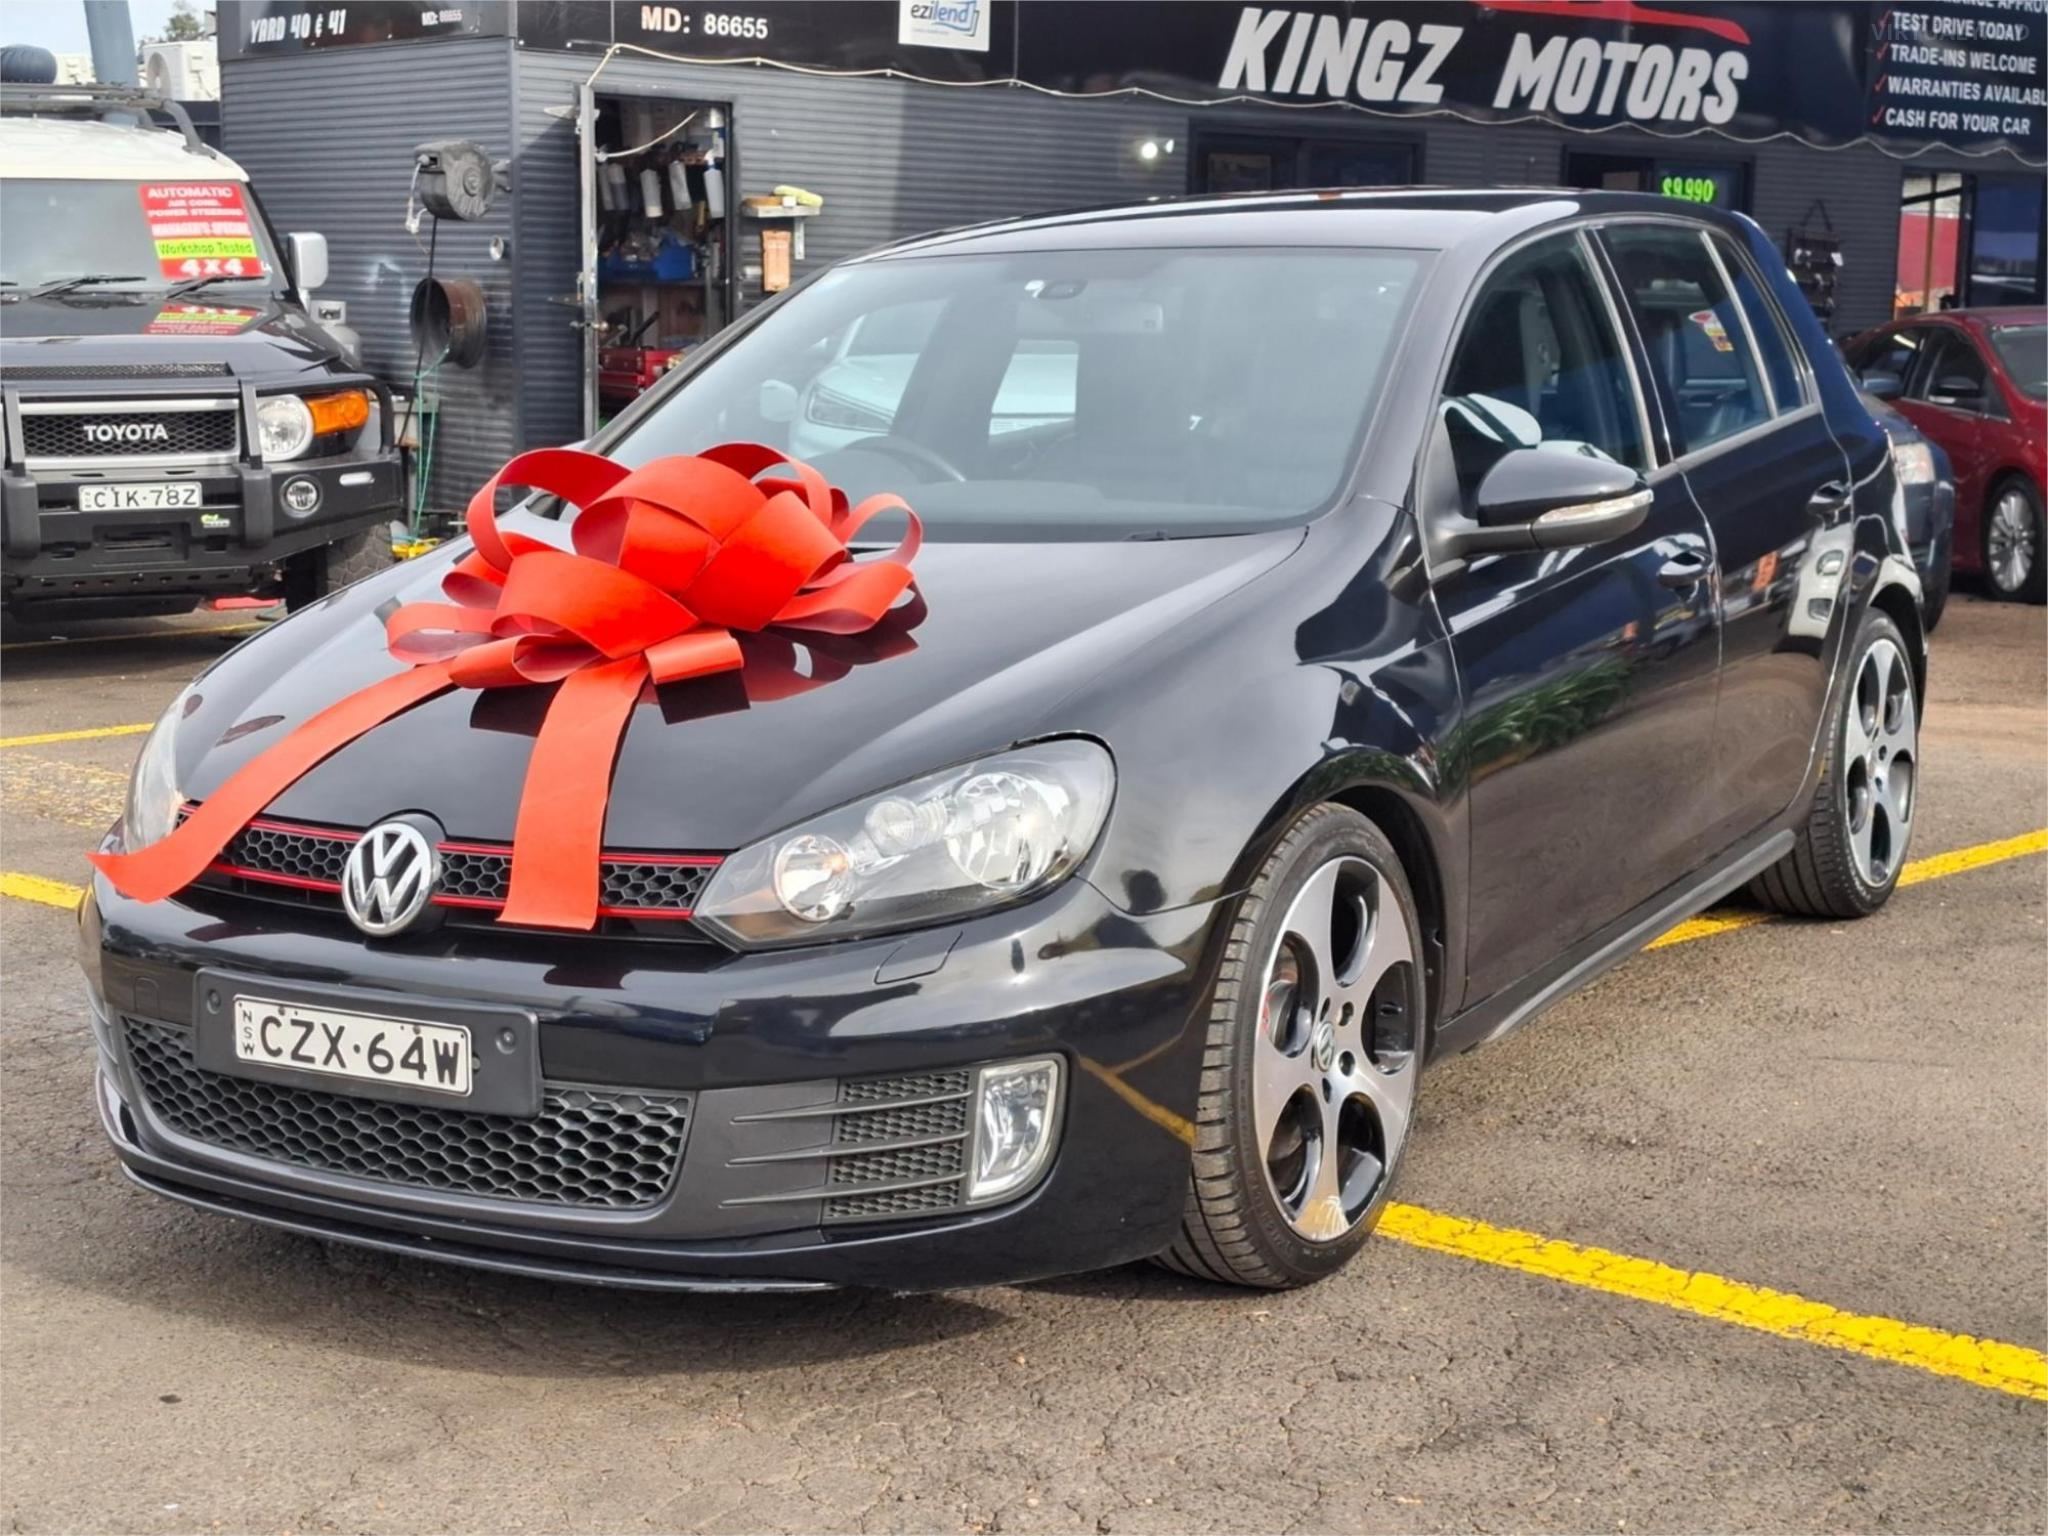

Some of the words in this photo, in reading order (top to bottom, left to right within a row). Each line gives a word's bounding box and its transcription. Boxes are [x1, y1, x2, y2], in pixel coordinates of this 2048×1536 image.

[250, 16, 285, 43] YARD
[289, 13, 311, 39] 40
[328, 9, 347, 35] 41
[641, 6, 690, 33] MD:
[703, 13, 768, 39] 86655
[1893, 11, 1929, 32] TEST
[1932, 16, 1974, 37] DRIVE
[1978, 20, 2024, 41] TODAY
[1218, 7, 1463, 104] KINGZ
[1493, 32, 1750, 125] MOTORS
[1891, 44, 1966, 68] TRADE-INS
[1970, 51, 2037, 74] WELCOME
[1888, 76, 1981, 101] WARRANTIES
[1885, 107, 1926, 128] CASH
[1929, 111, 1959, 130] FOR
[1963, 114, 2000, 133] YOUR
[2003, 117, 2031, 135] CAR
[147, 186, 234, 198] AUTOMATIC
[159, 243, 214, 255] Workshop
[216, 241, 253, 253] Tested
[83, 424, 168, 442] TOYOTA
